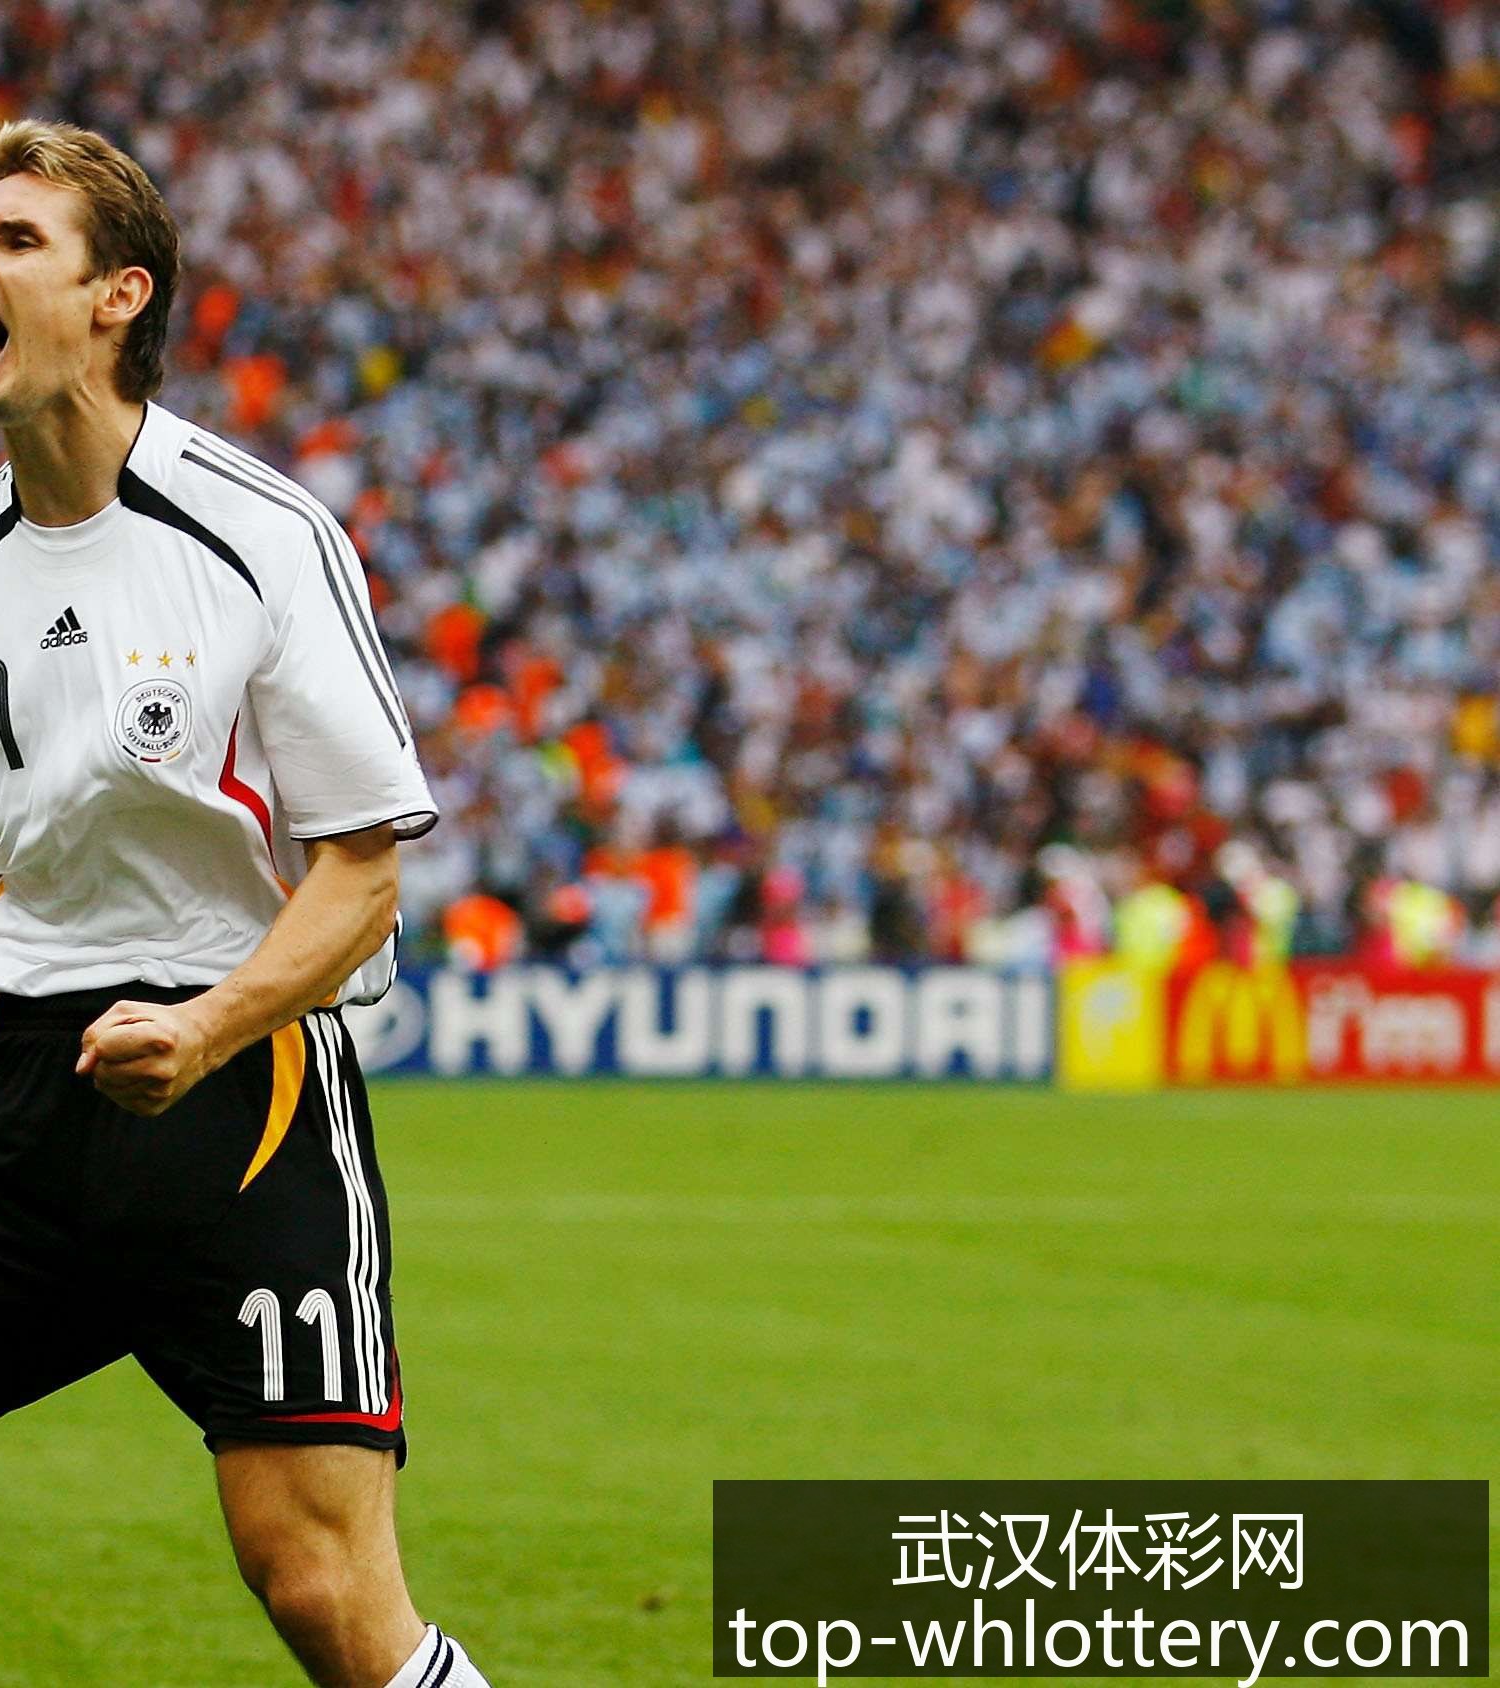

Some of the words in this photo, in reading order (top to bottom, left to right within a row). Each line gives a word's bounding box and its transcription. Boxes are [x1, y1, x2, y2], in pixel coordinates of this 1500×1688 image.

[40, 630, 88, 649] adidas
[428, 968, 1046, 1077] HYUNDAI
[237, 1288, 343, 1402] 11
